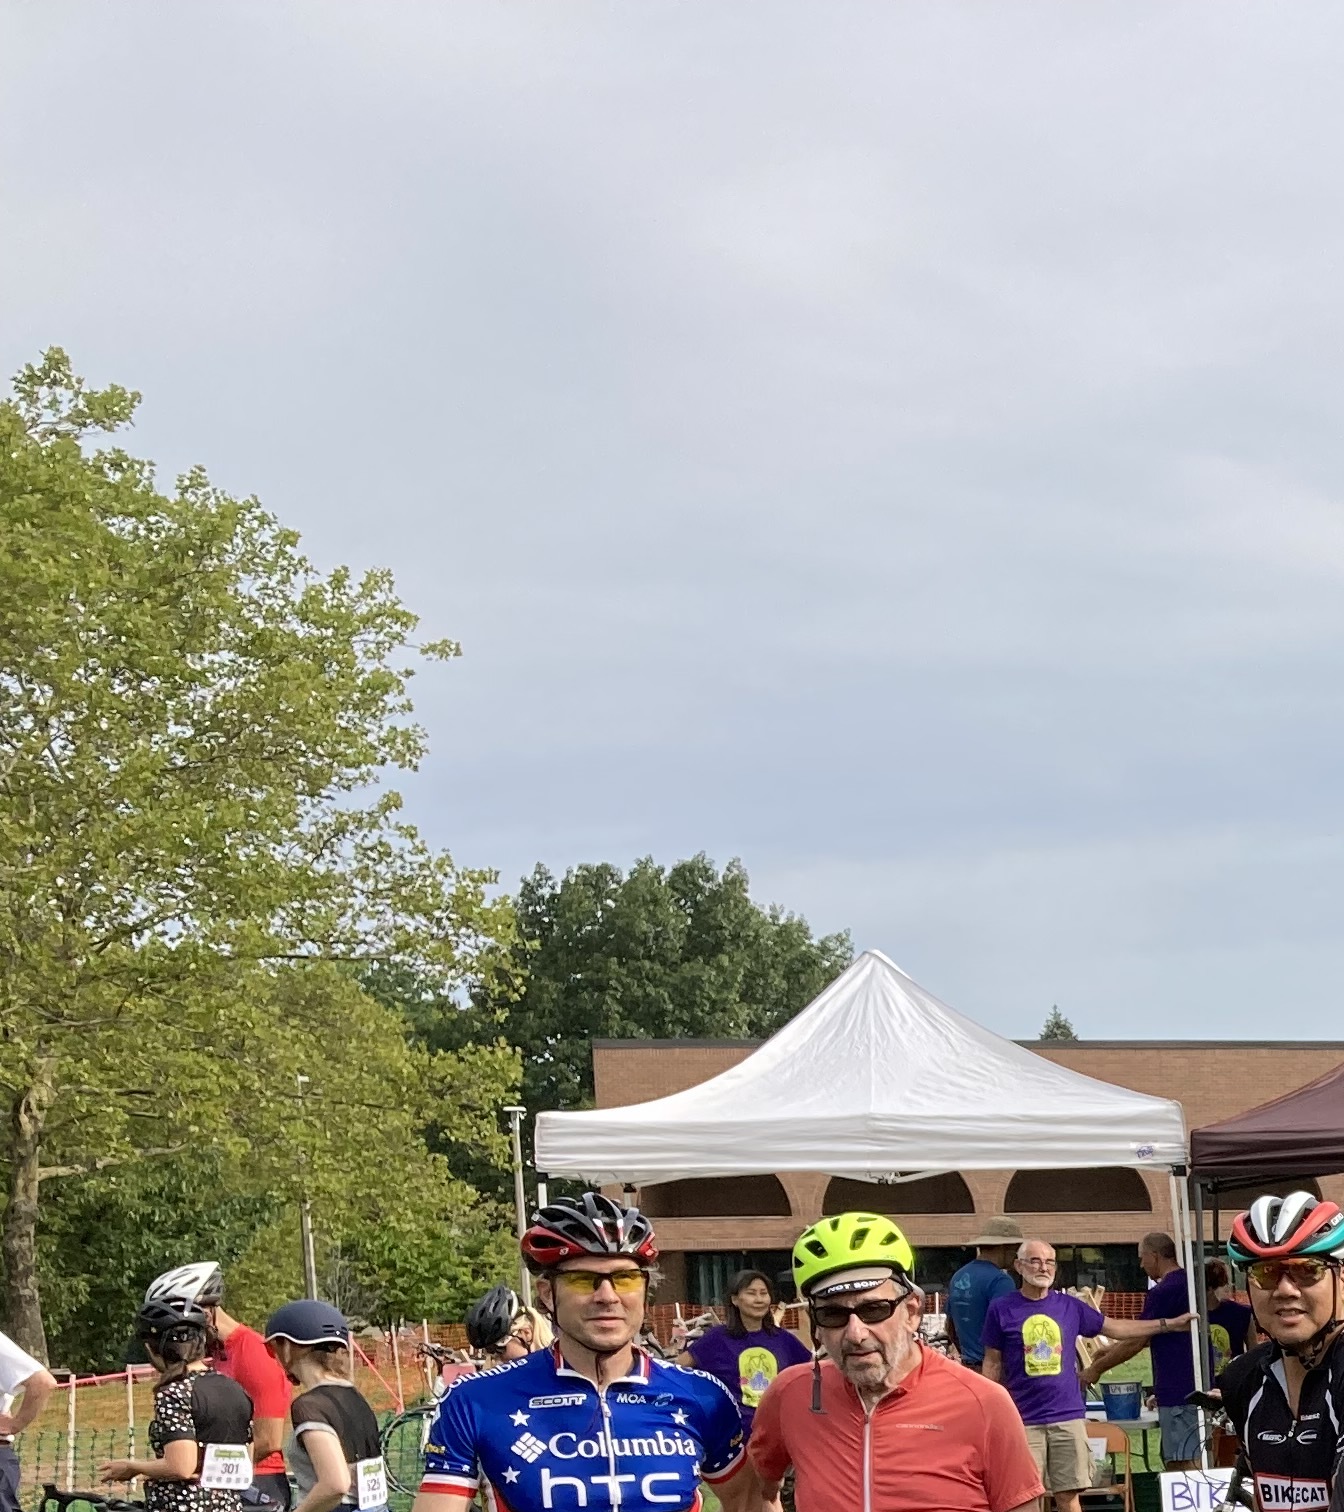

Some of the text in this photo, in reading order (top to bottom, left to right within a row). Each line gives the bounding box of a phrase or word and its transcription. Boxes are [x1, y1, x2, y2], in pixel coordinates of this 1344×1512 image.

[549, 1430, 697, 1459] Columbia
[220, 1463, 240, 1475] 301
[1260, 1484, 1325, 1503] BIKECAT
